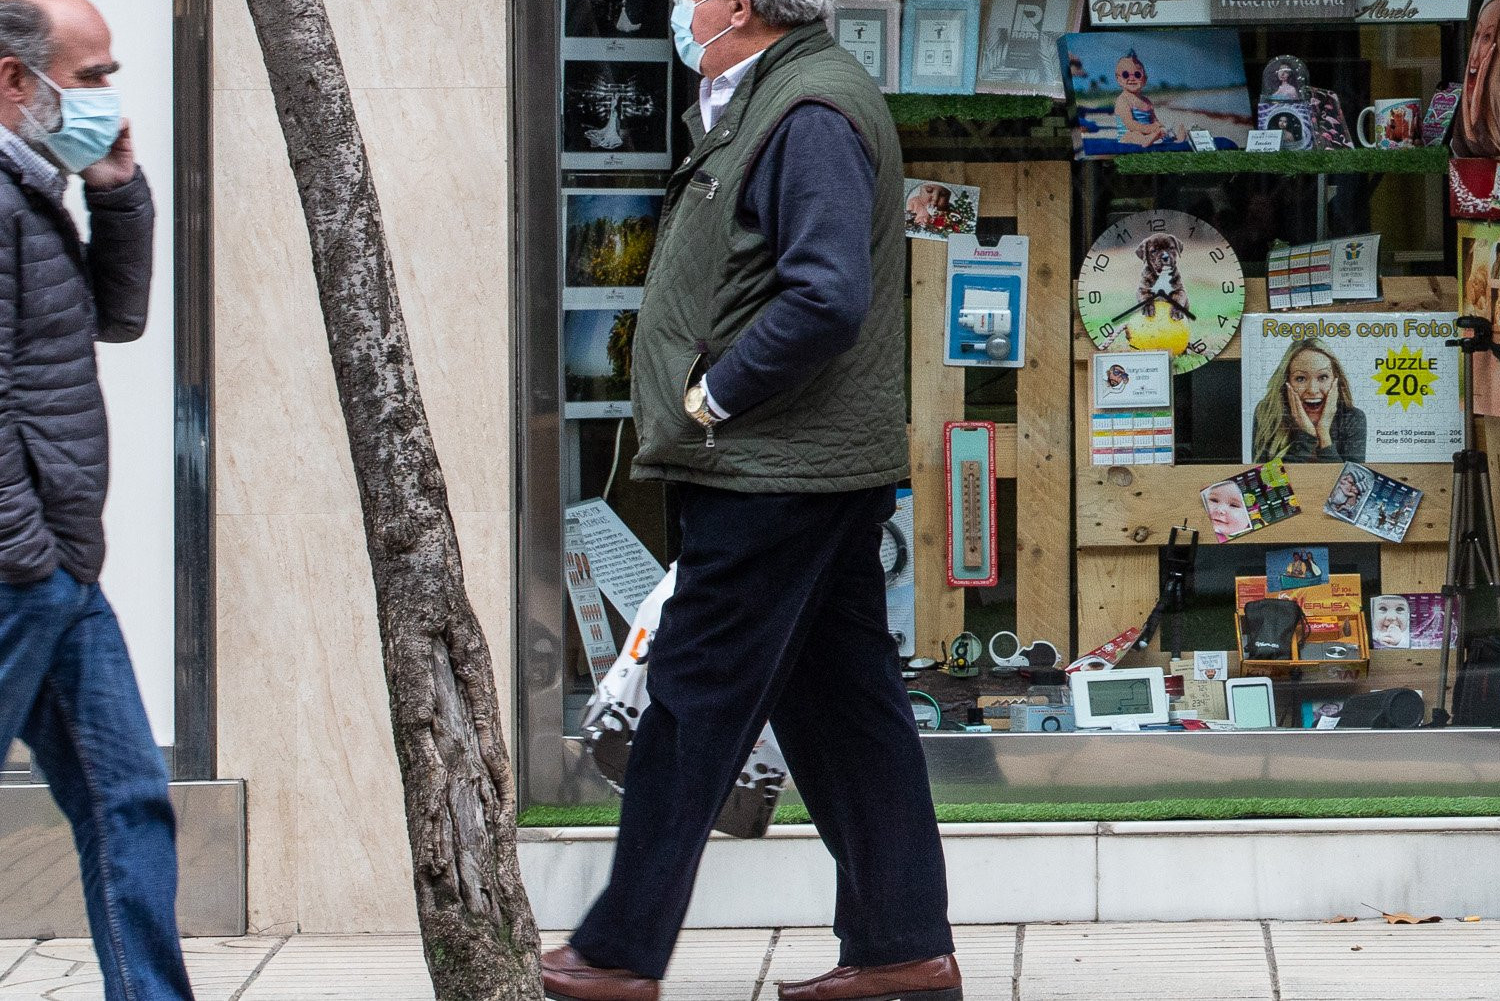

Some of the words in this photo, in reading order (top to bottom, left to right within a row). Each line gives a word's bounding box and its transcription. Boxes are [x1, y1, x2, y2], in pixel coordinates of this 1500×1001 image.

[1146, 218, 1166, 232] 12
[1188, 226, 1196, 238] 1
[1117, 228, 1132, 244] 11
[973, 248, 1001, 257] hama
[1209, 247, 1225, 264] 2
[1092, 253, 1110, 273] 10
[1221, 280, 1235, 294] 3
[1088, 290, 1102, 304] 9
[1217, 314, 1228, 328] 4
[1099, 322, 1114, 338] 8
[1261, 317, 1351, 341] Regalos
[1356, 319, 1398, 338] con
[1374, 358, 1438, 371] PUZZLE
[1385, 373, 1429, 396] 20€
[1413, 429, 1435, 438] piezas
[1413, 437, 1435, 446] piezas
